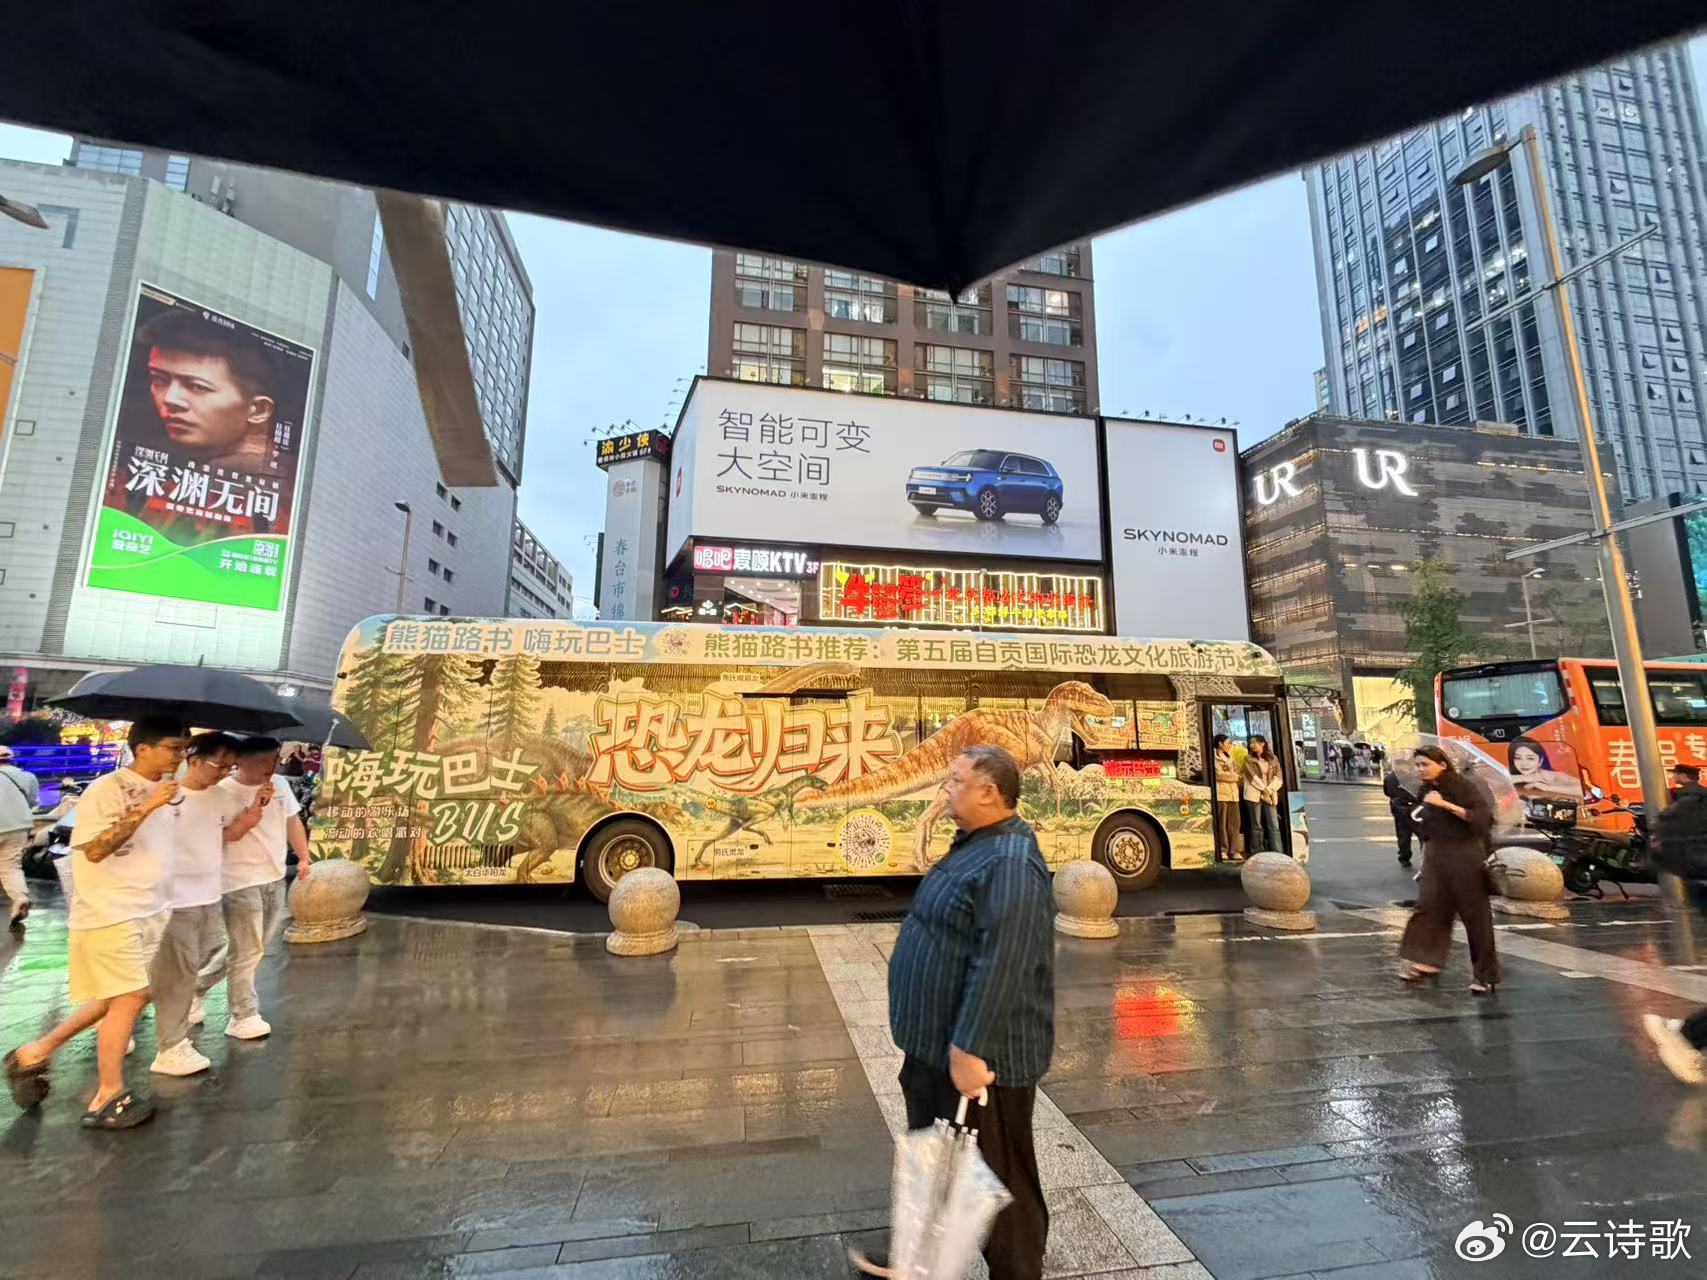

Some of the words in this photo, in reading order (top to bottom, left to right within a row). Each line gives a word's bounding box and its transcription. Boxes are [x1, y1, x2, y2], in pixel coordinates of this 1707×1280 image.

[718, 408, 871, 453] 智能可变
[717, 446, 831, 486] 大空间
[1253, 460, 1304, 505] UR
[1352, 448, 1418, 497] UR
[125, 456, 279, 522] 深渊无间
[716, 485, 787, 498] SKYNOMAD
[1123, 528, 1228, 545] SKYNOMAD
[388, 624, 514, 653] 熊猫路书
[523, 629, 644, 656] 嗨玩巴士
[586, 688, 903, 793] 恐龙归来
[325, 747, 539, 799] 嗨玩巴士
[428, 801, 526, 844] BUS
